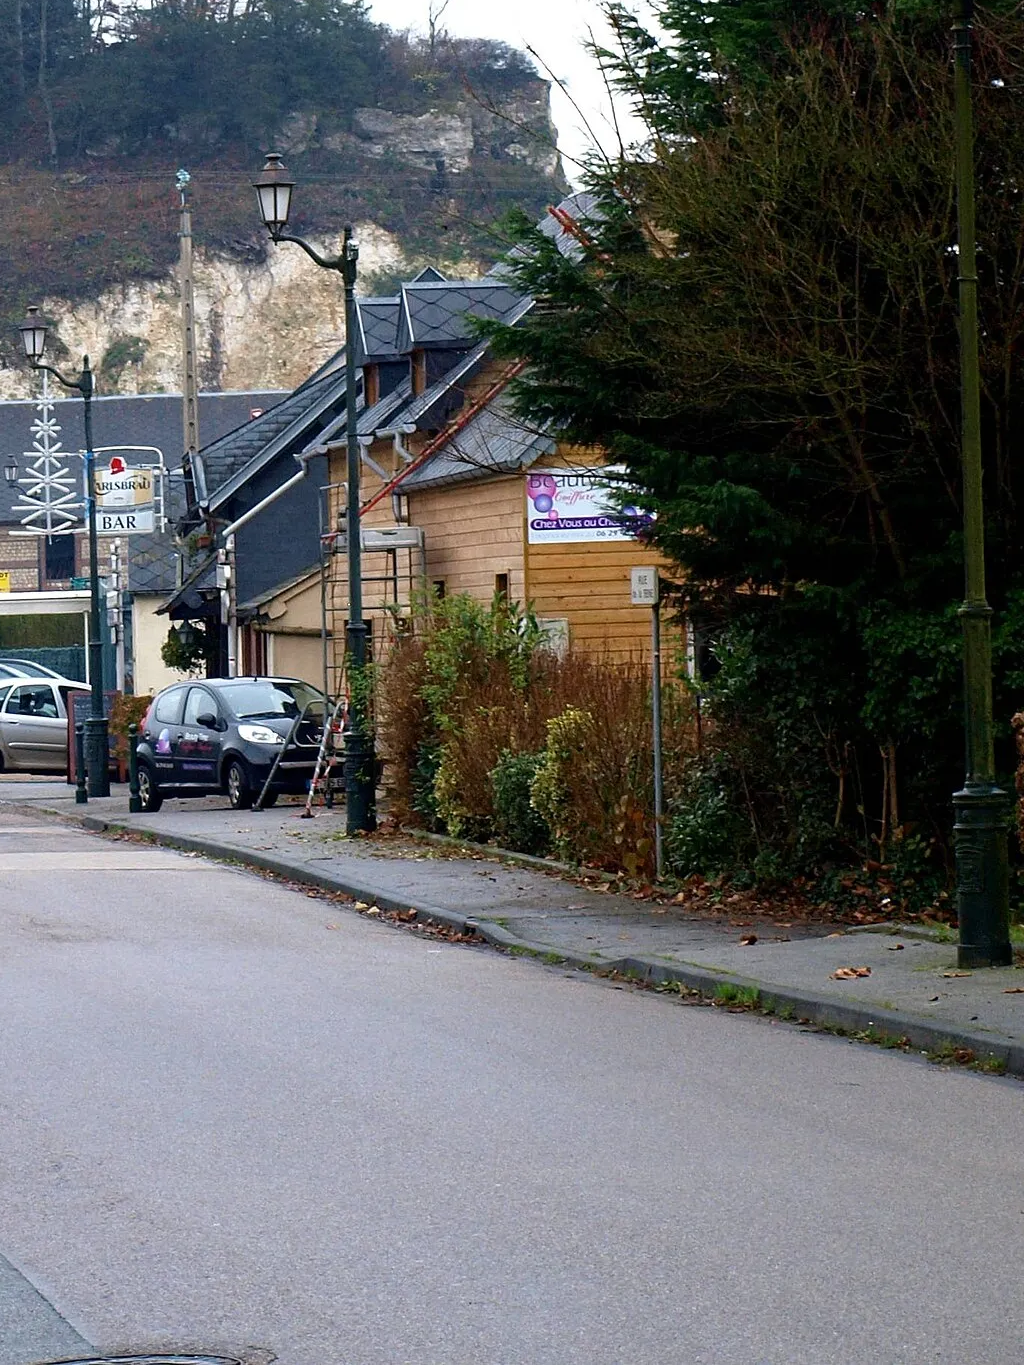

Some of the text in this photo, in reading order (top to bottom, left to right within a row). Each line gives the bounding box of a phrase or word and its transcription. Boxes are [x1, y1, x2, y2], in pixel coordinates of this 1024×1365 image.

[102, 516, 136, 529] BAR
[533, 520, 557, 529] Chez
[557, 519, 582, 528] Vous
